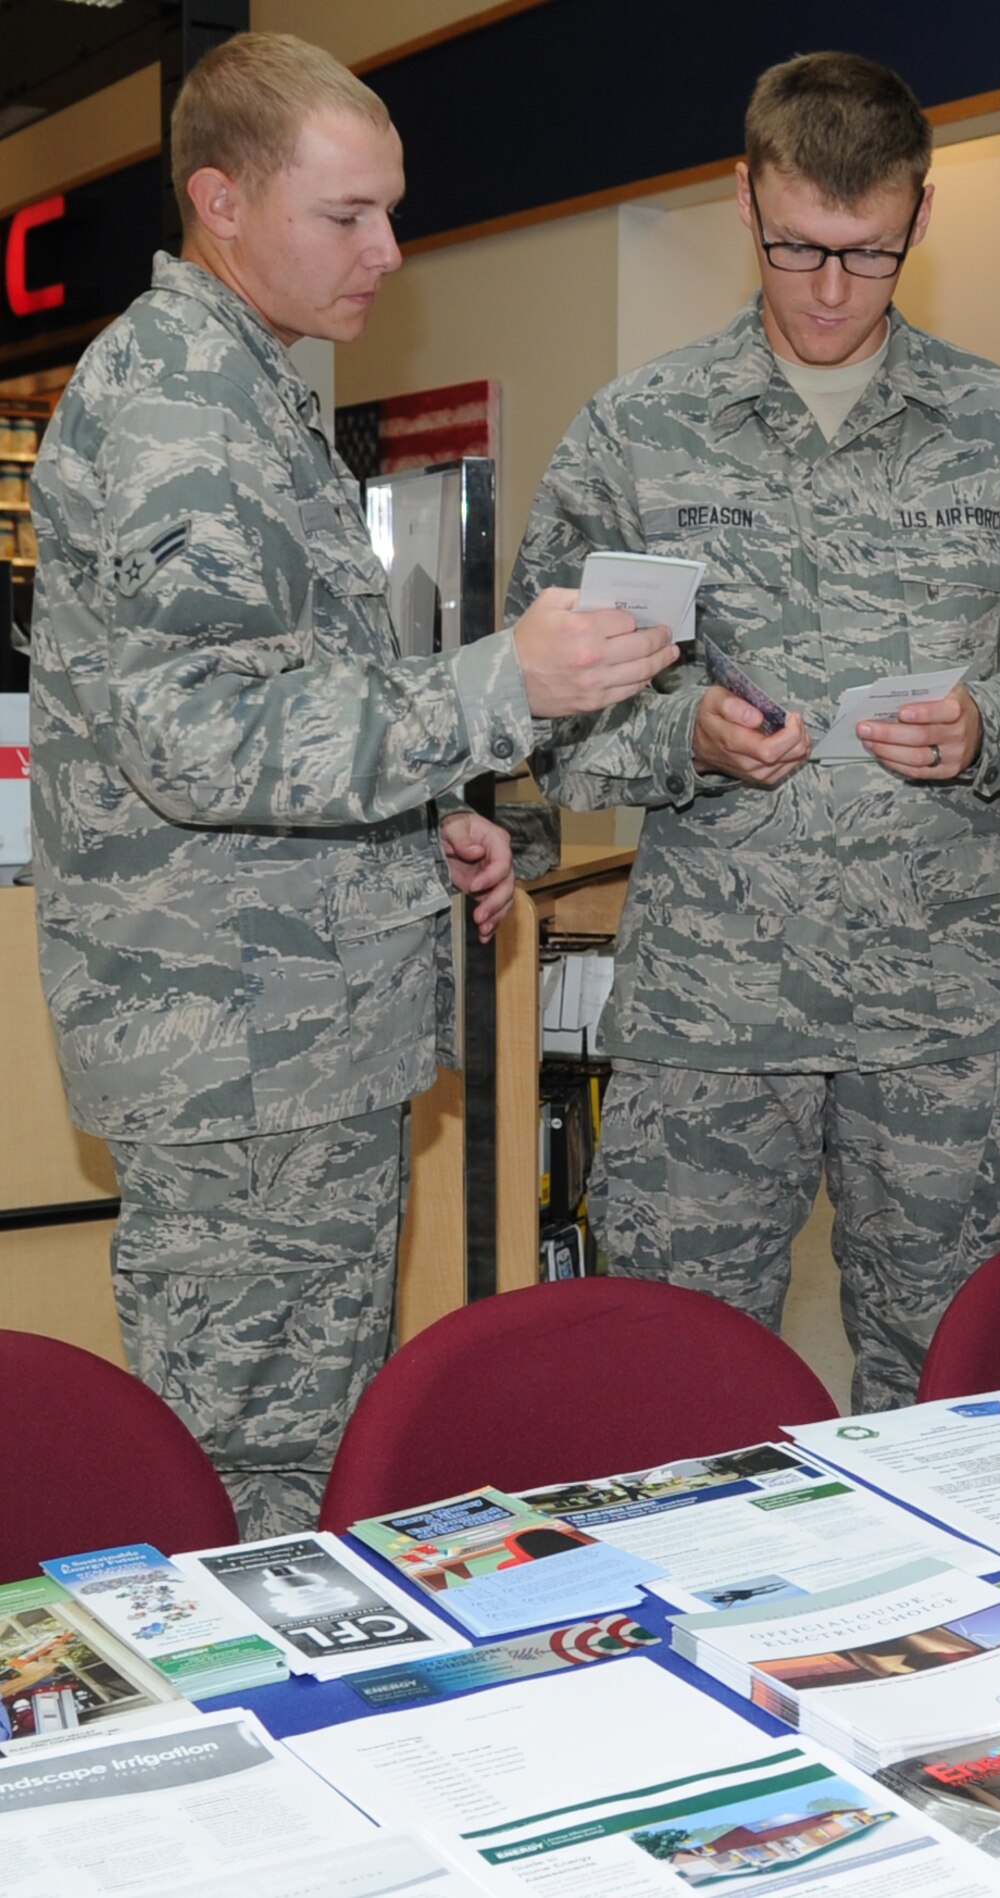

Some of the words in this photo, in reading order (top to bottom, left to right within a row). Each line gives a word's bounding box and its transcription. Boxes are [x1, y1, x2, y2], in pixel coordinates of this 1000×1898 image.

[5, 196, 65, 316] C
[678, 506, 752, 528] CREASON
[901, 511, 932, 528] U.S.
[936, 508, 962, 528] AIR
[287, 1614, 409, 1649] CFL
[750, 1617, 853, 1641] OFFICIAL
[857, 1595, 924, 1621] GUIDE
[762, 1622, 870, 1648] ELECTRIC
[876, 1596, 959, 1626] CHOICE
[111, 1740, 219, 1771] Irrigation
[494, 1841, 544, 1860] ENERGY
